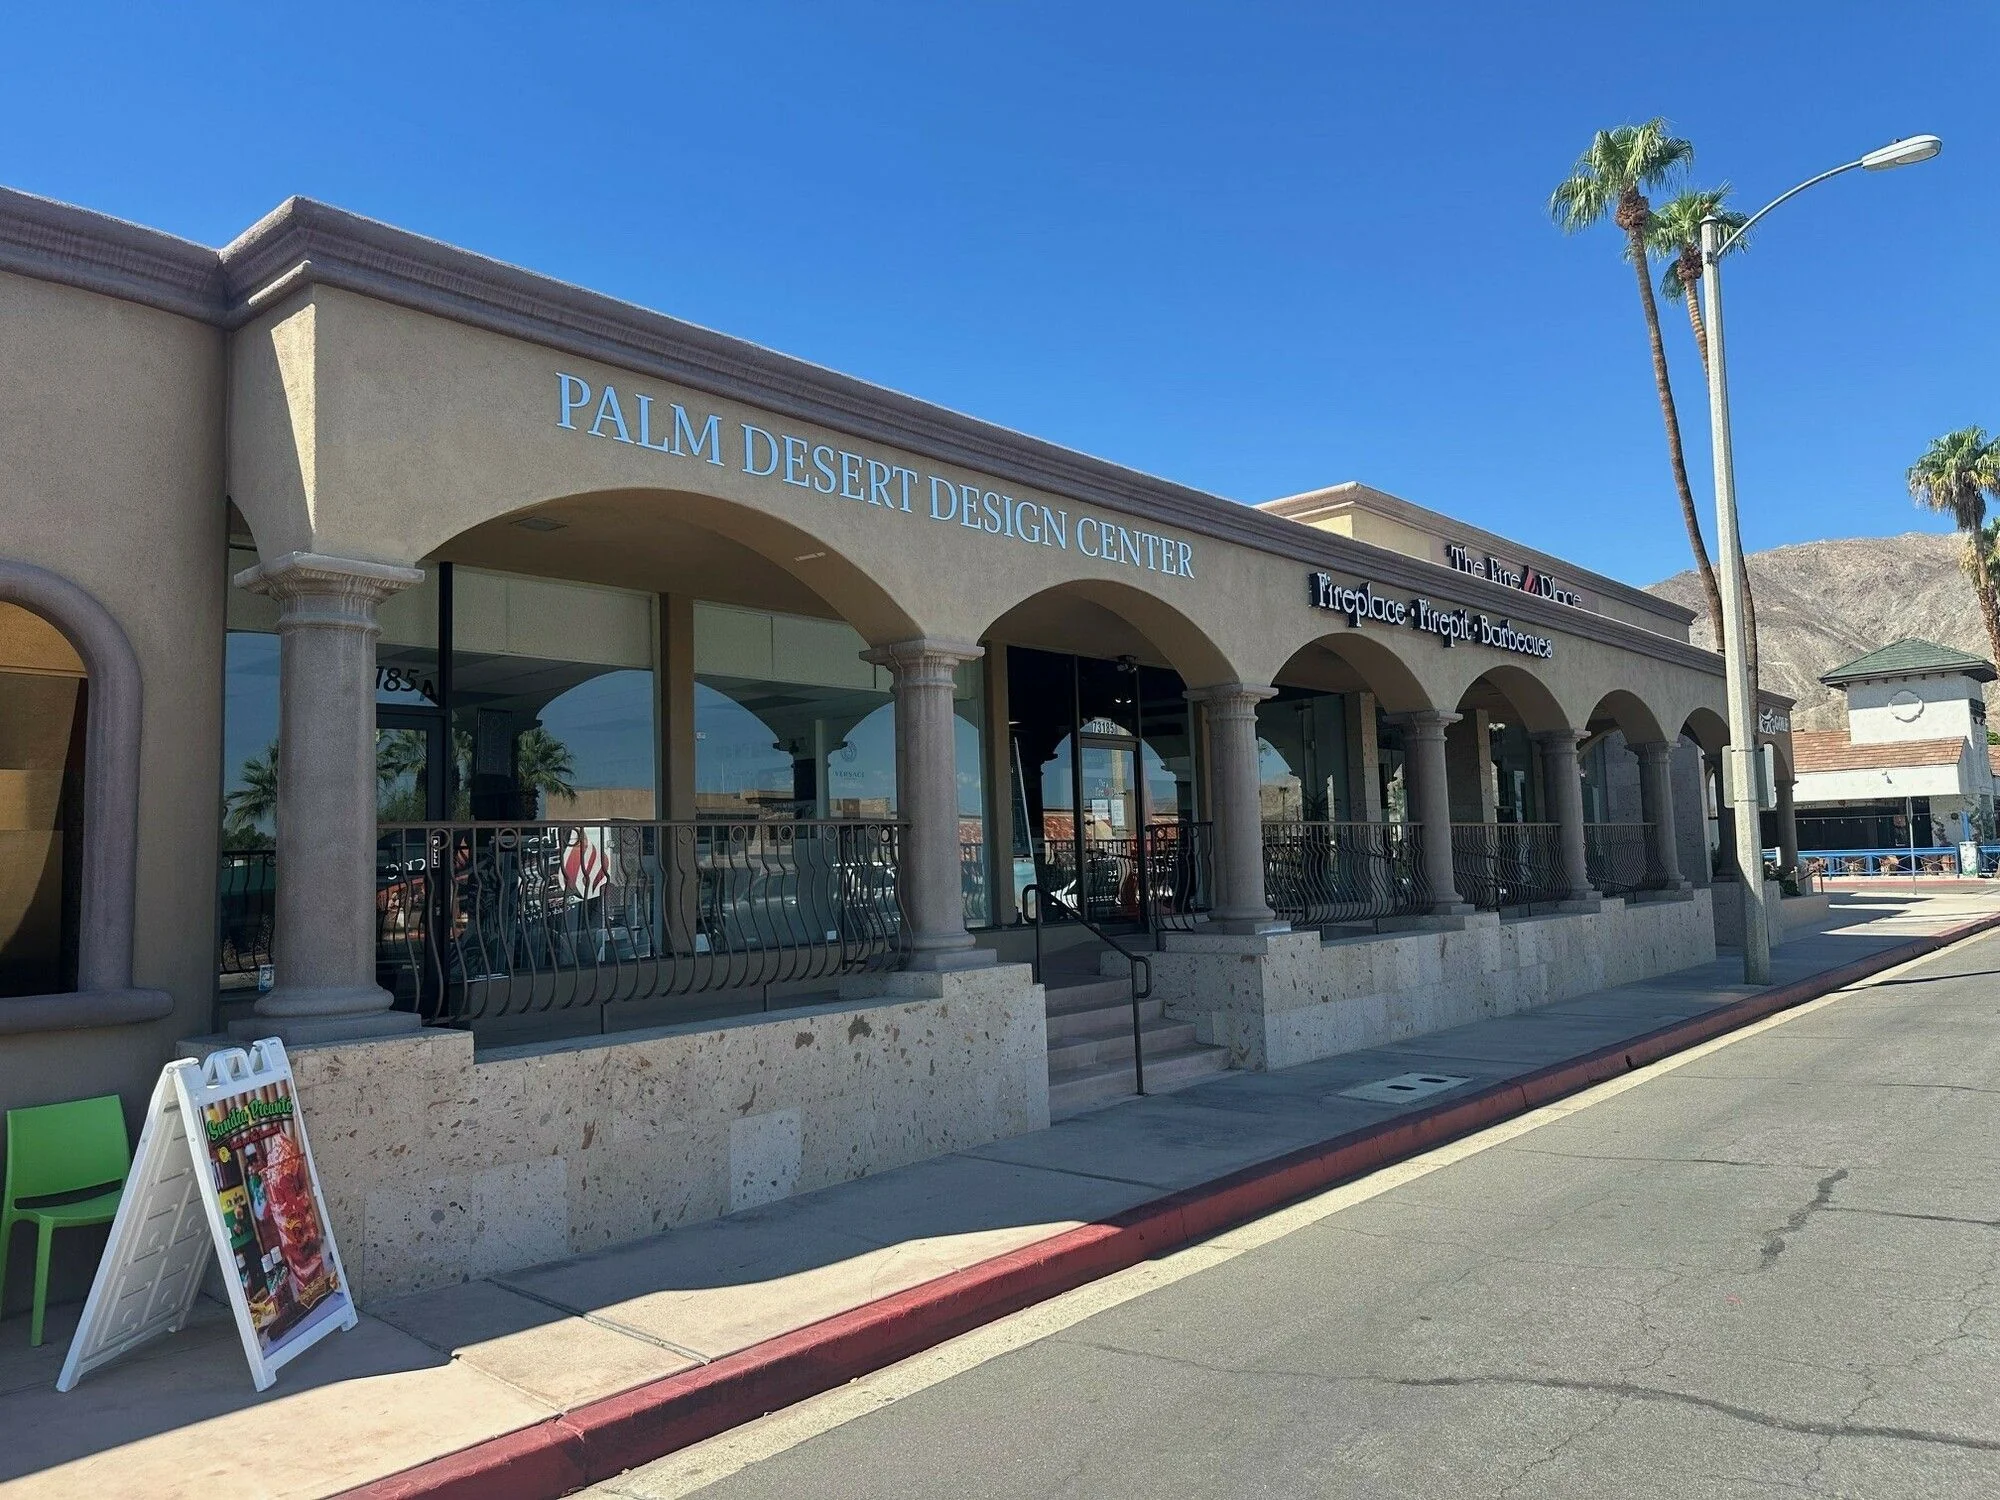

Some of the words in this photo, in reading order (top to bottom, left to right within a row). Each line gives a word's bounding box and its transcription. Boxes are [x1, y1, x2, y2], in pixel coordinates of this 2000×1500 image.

[555, 372, 724, 467] PALM
[741, 423, 918, 513] DESERT
[928, 475, 1067, 549] DESIGN
[1076, 517, 1195, 579] CENTER
[1315, 572, 1406, 627] Fireplace
[1418, 599, 1471, 647] Firepit
[1480, 614, 1553, 658] Barbecues
[1449, 544, 1485, 580] The
[1488, 557, 1521, 589] Fire
[1540, 574, 1582, 608] Place
